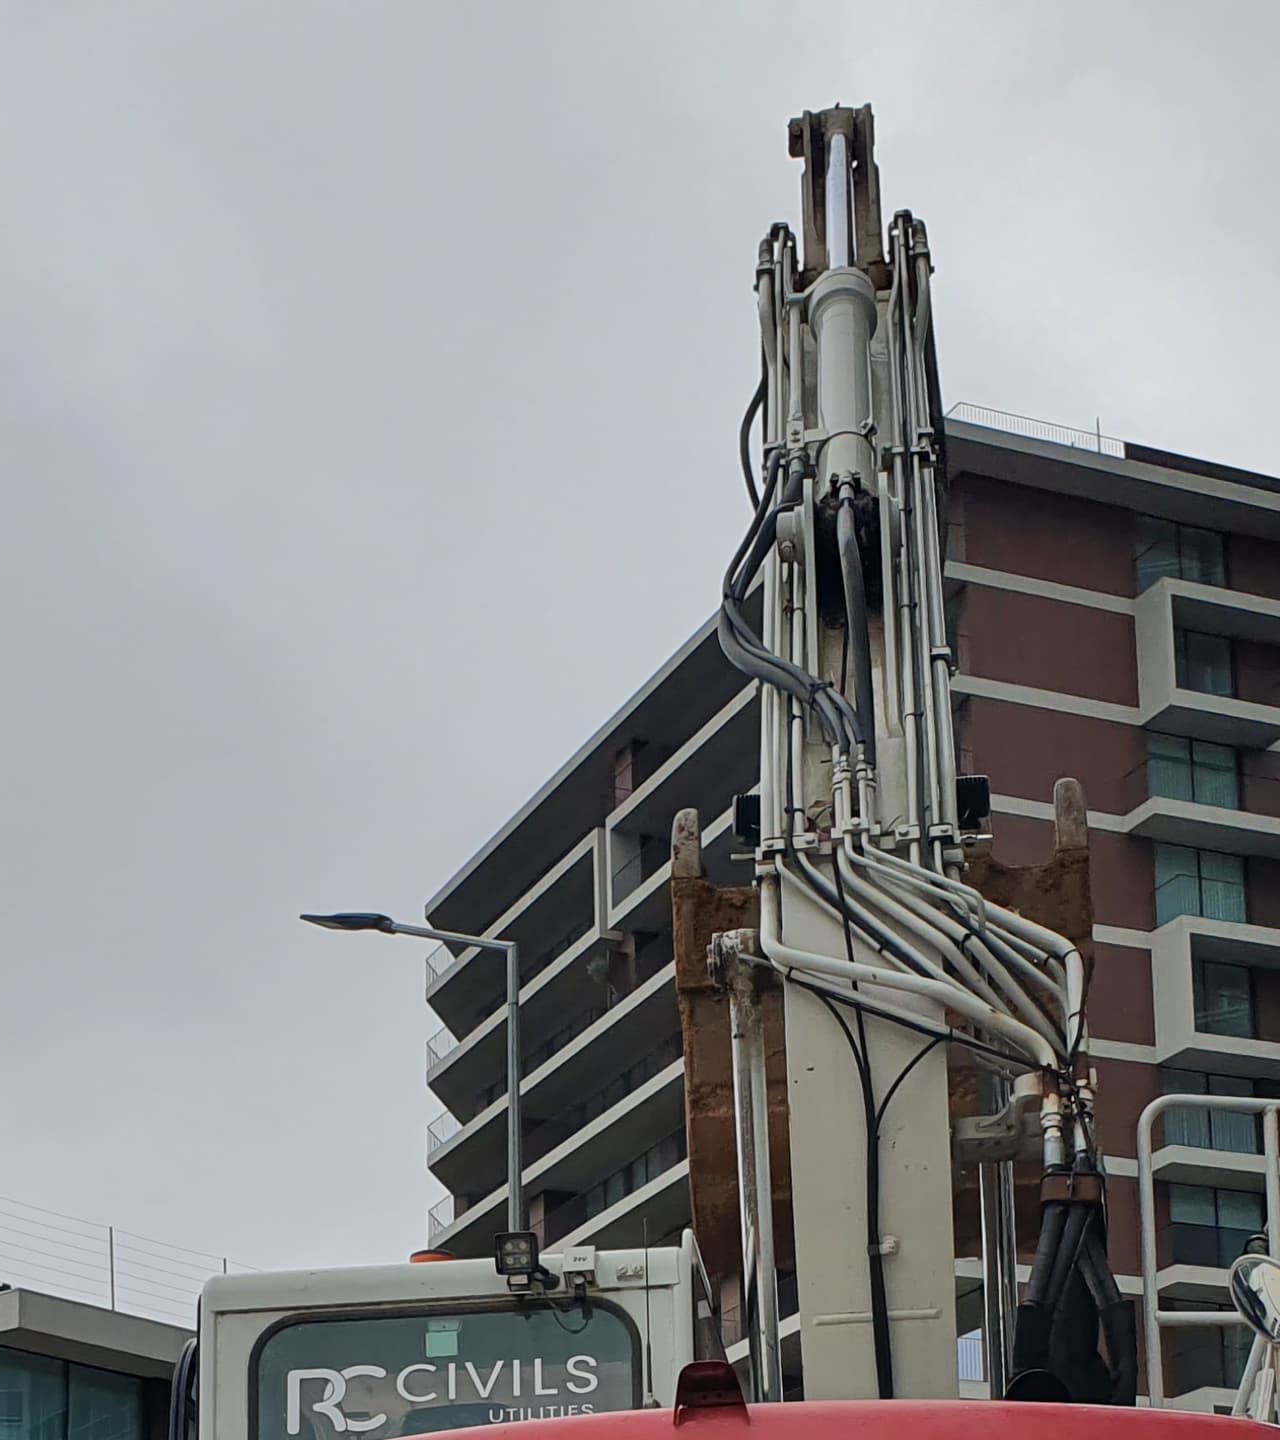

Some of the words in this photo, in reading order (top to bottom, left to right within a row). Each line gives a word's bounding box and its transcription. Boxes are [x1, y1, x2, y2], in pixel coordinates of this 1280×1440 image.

[286, 1364, 387, 1435] RC
[396, 1355, 599, 1402] CIVILS
[488, 1403, 596, 1423] UTILITIES
